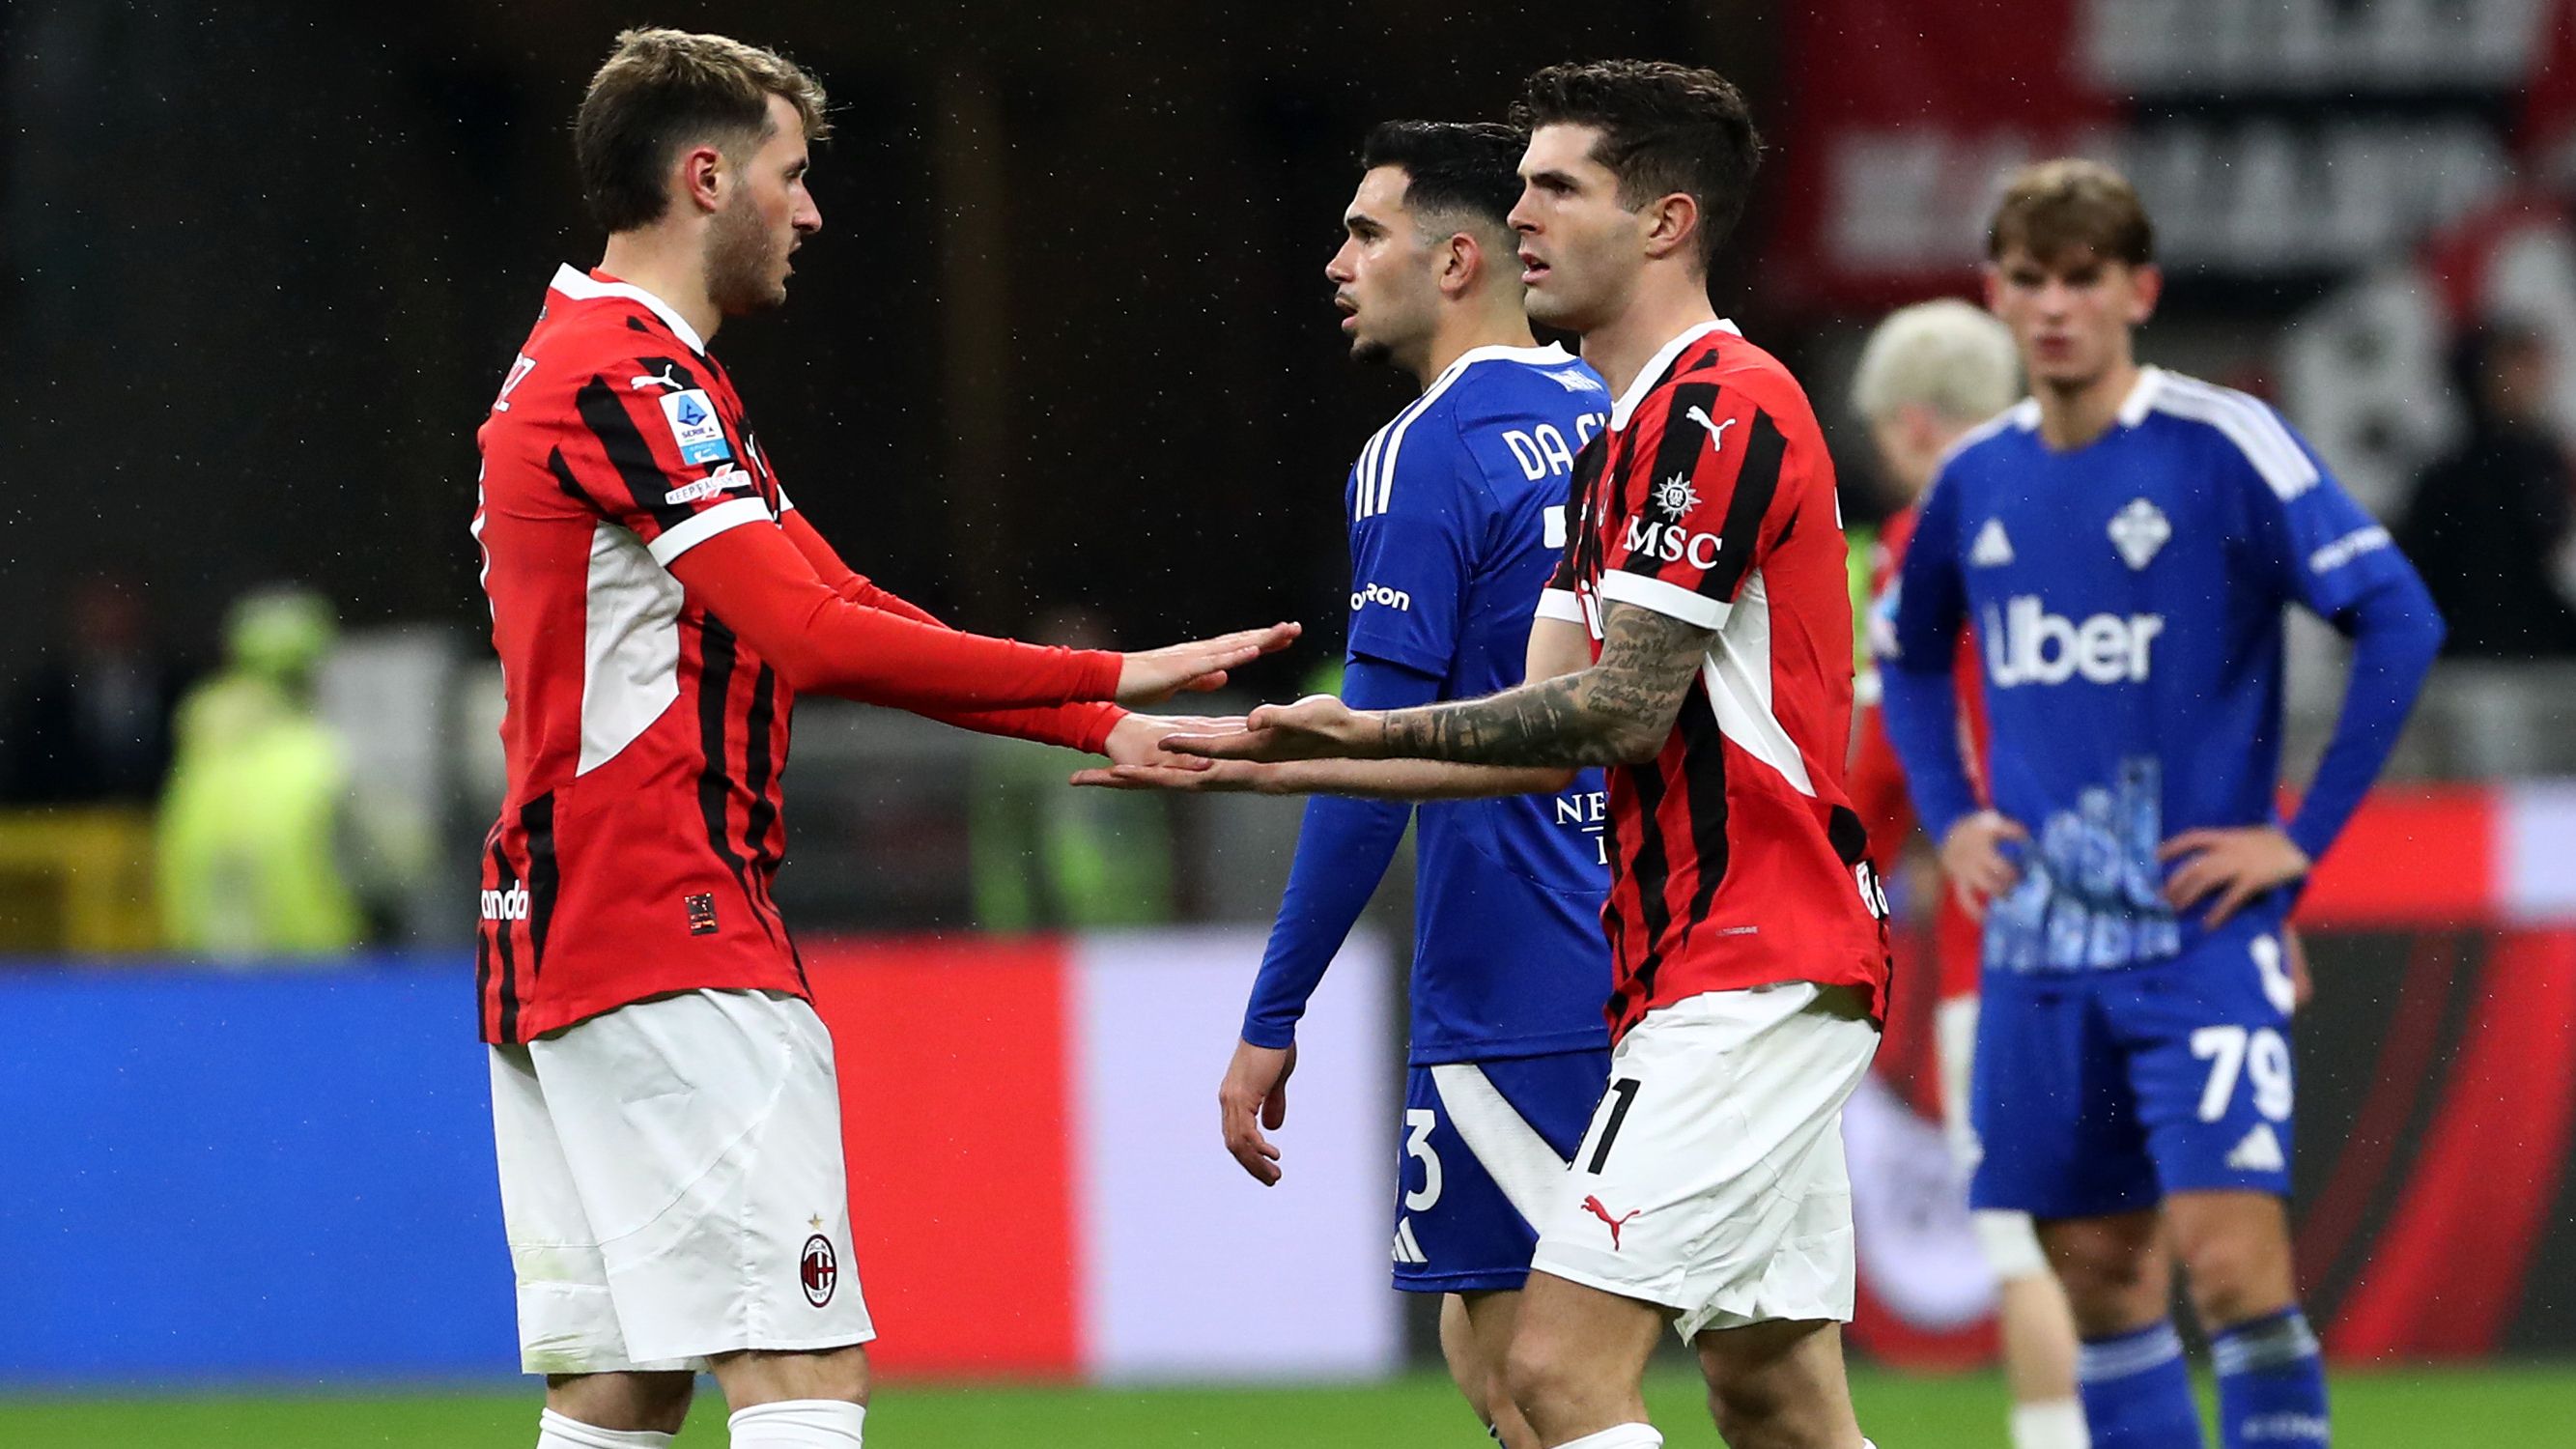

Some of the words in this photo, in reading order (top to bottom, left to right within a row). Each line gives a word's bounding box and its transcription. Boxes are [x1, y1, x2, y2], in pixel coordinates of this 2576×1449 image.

[1502, 423, 1574, 481] DA
[1623, 515, 1722, 570] MSC
[1982, 592, 2165, 689] Uber
[481, 878, 529, 921] anda
[2189, 1024, 2295, 1122] 79
[1405, 1108, 1443, 1211] 3
